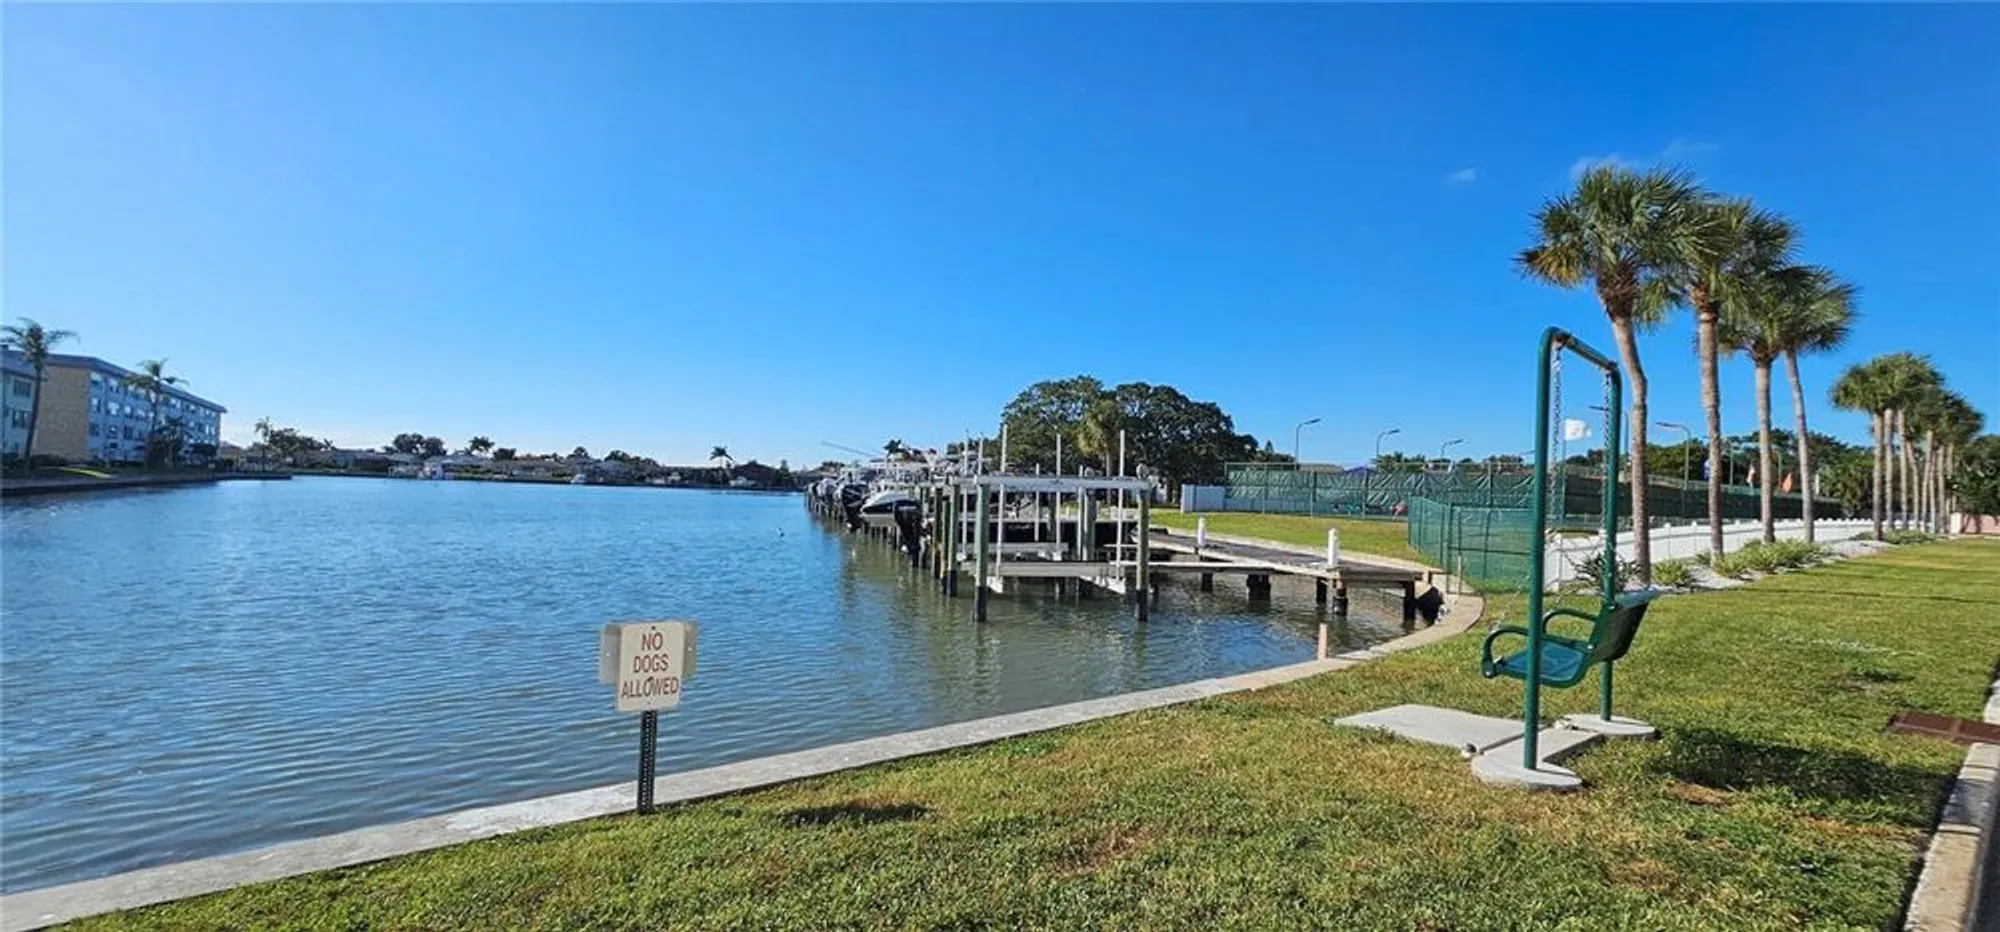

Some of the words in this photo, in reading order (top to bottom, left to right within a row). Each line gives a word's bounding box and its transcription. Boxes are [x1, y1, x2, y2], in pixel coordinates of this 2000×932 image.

[641, 632, 663, 651] NO
[633, 654, 669, 673] DOGS
[621, 676, 679, 698] ALLOWED
